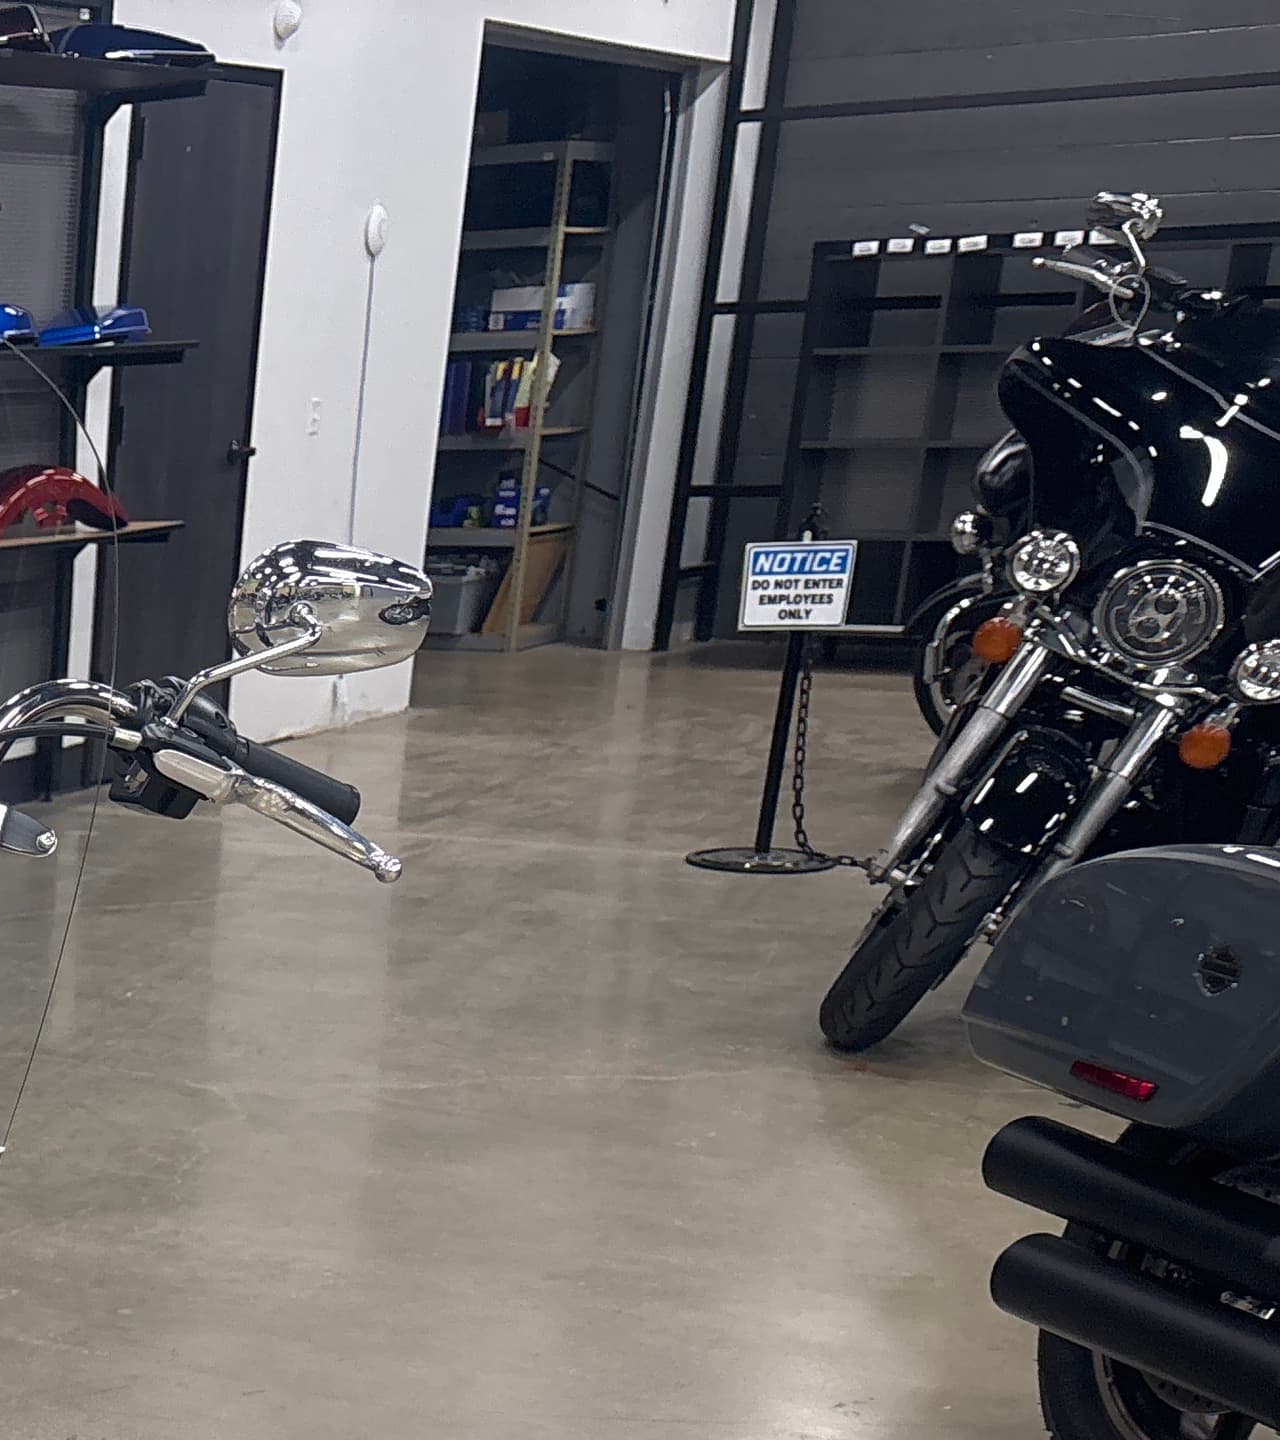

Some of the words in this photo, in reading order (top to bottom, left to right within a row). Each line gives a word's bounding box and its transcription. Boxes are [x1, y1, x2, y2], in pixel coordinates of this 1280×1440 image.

[754, 551, 847, 573] NOTICE
[751, 579, 770, 590] DO
[773, 579, 801, 590] NOT
[803, 578, 844, 589] ENTER
[758, 593, 834, 605] EMPLOYEES
[777, 608, 813, 620] ONLY
